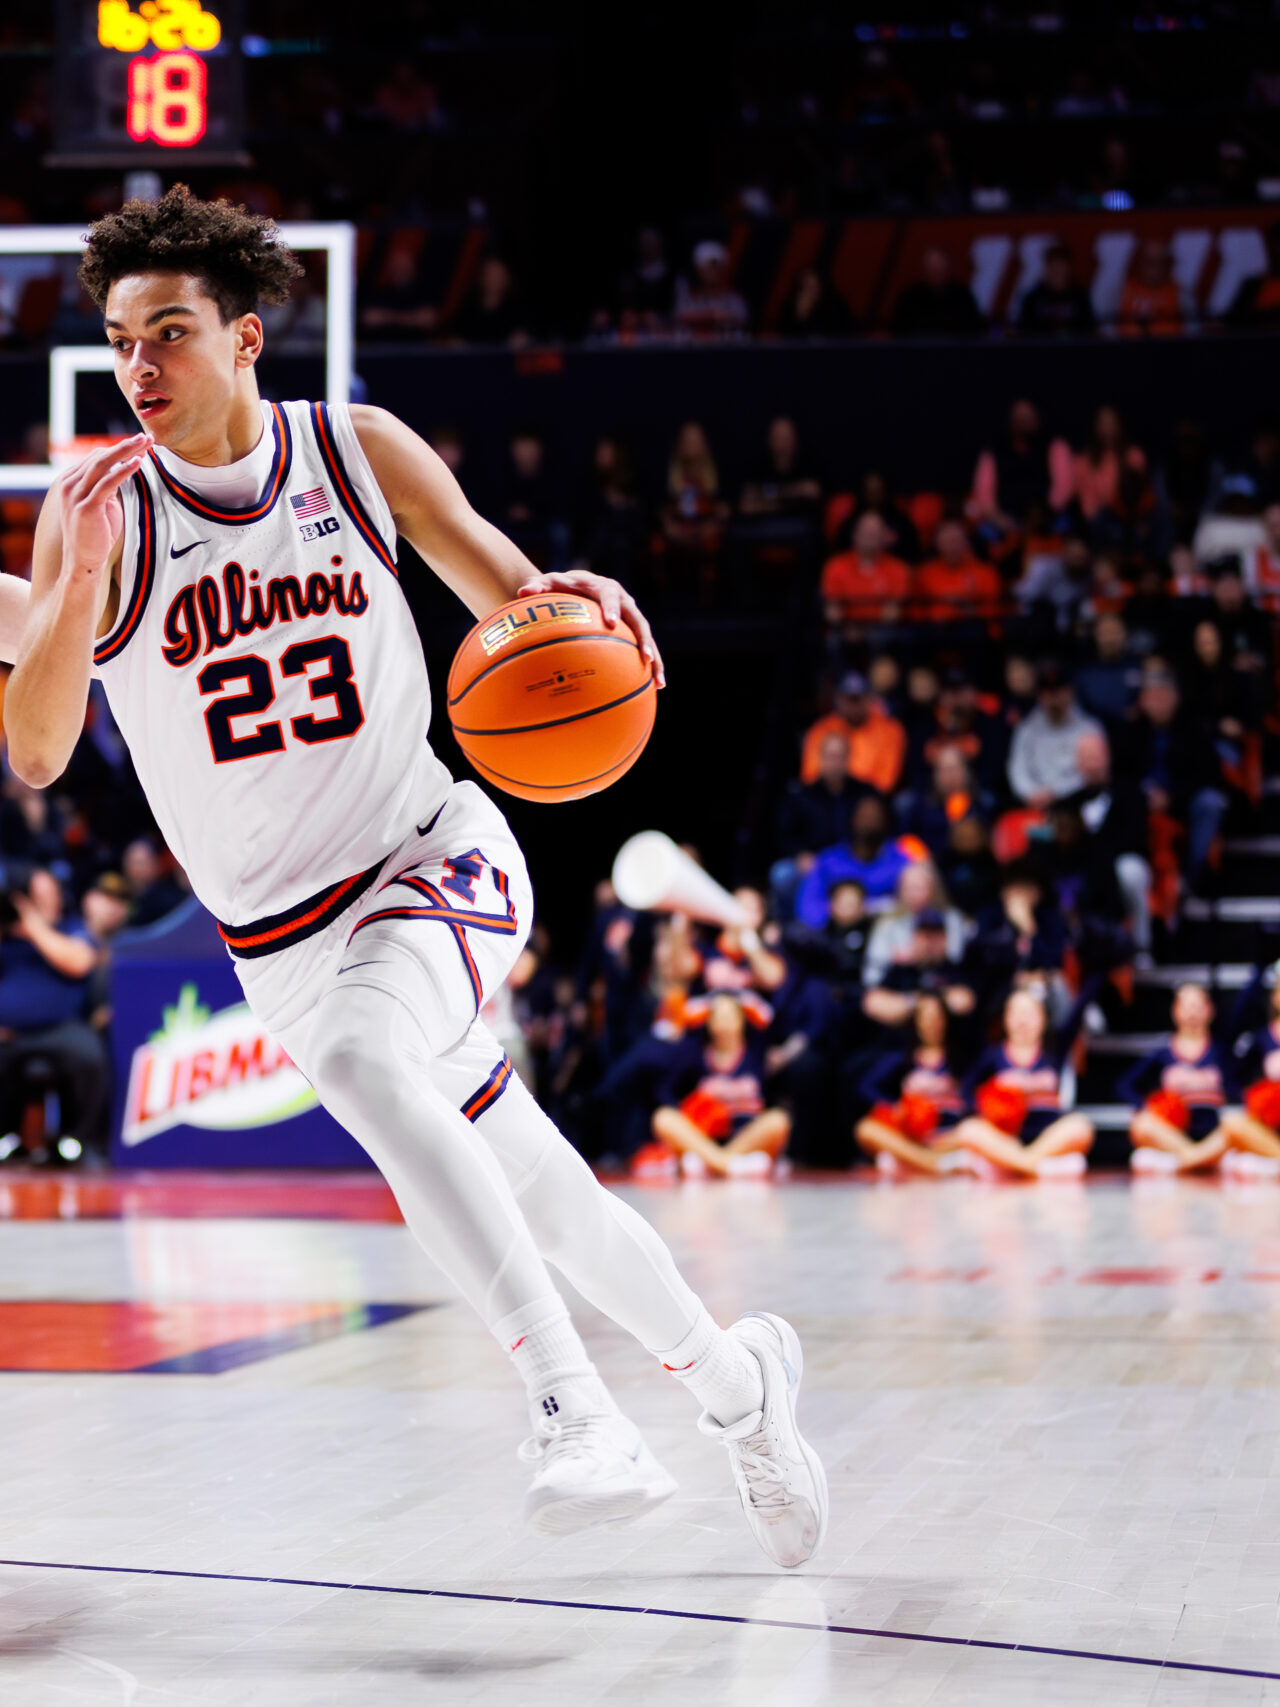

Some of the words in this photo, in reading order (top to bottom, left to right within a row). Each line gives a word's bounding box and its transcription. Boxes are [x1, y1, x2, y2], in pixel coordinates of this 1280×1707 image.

[127, 50, 207, 147] 18
[161, 554, 369, 668] Illinois
[196, 634, 365, 765] 23
[132, 1034, 302, 1124] LIBMA
